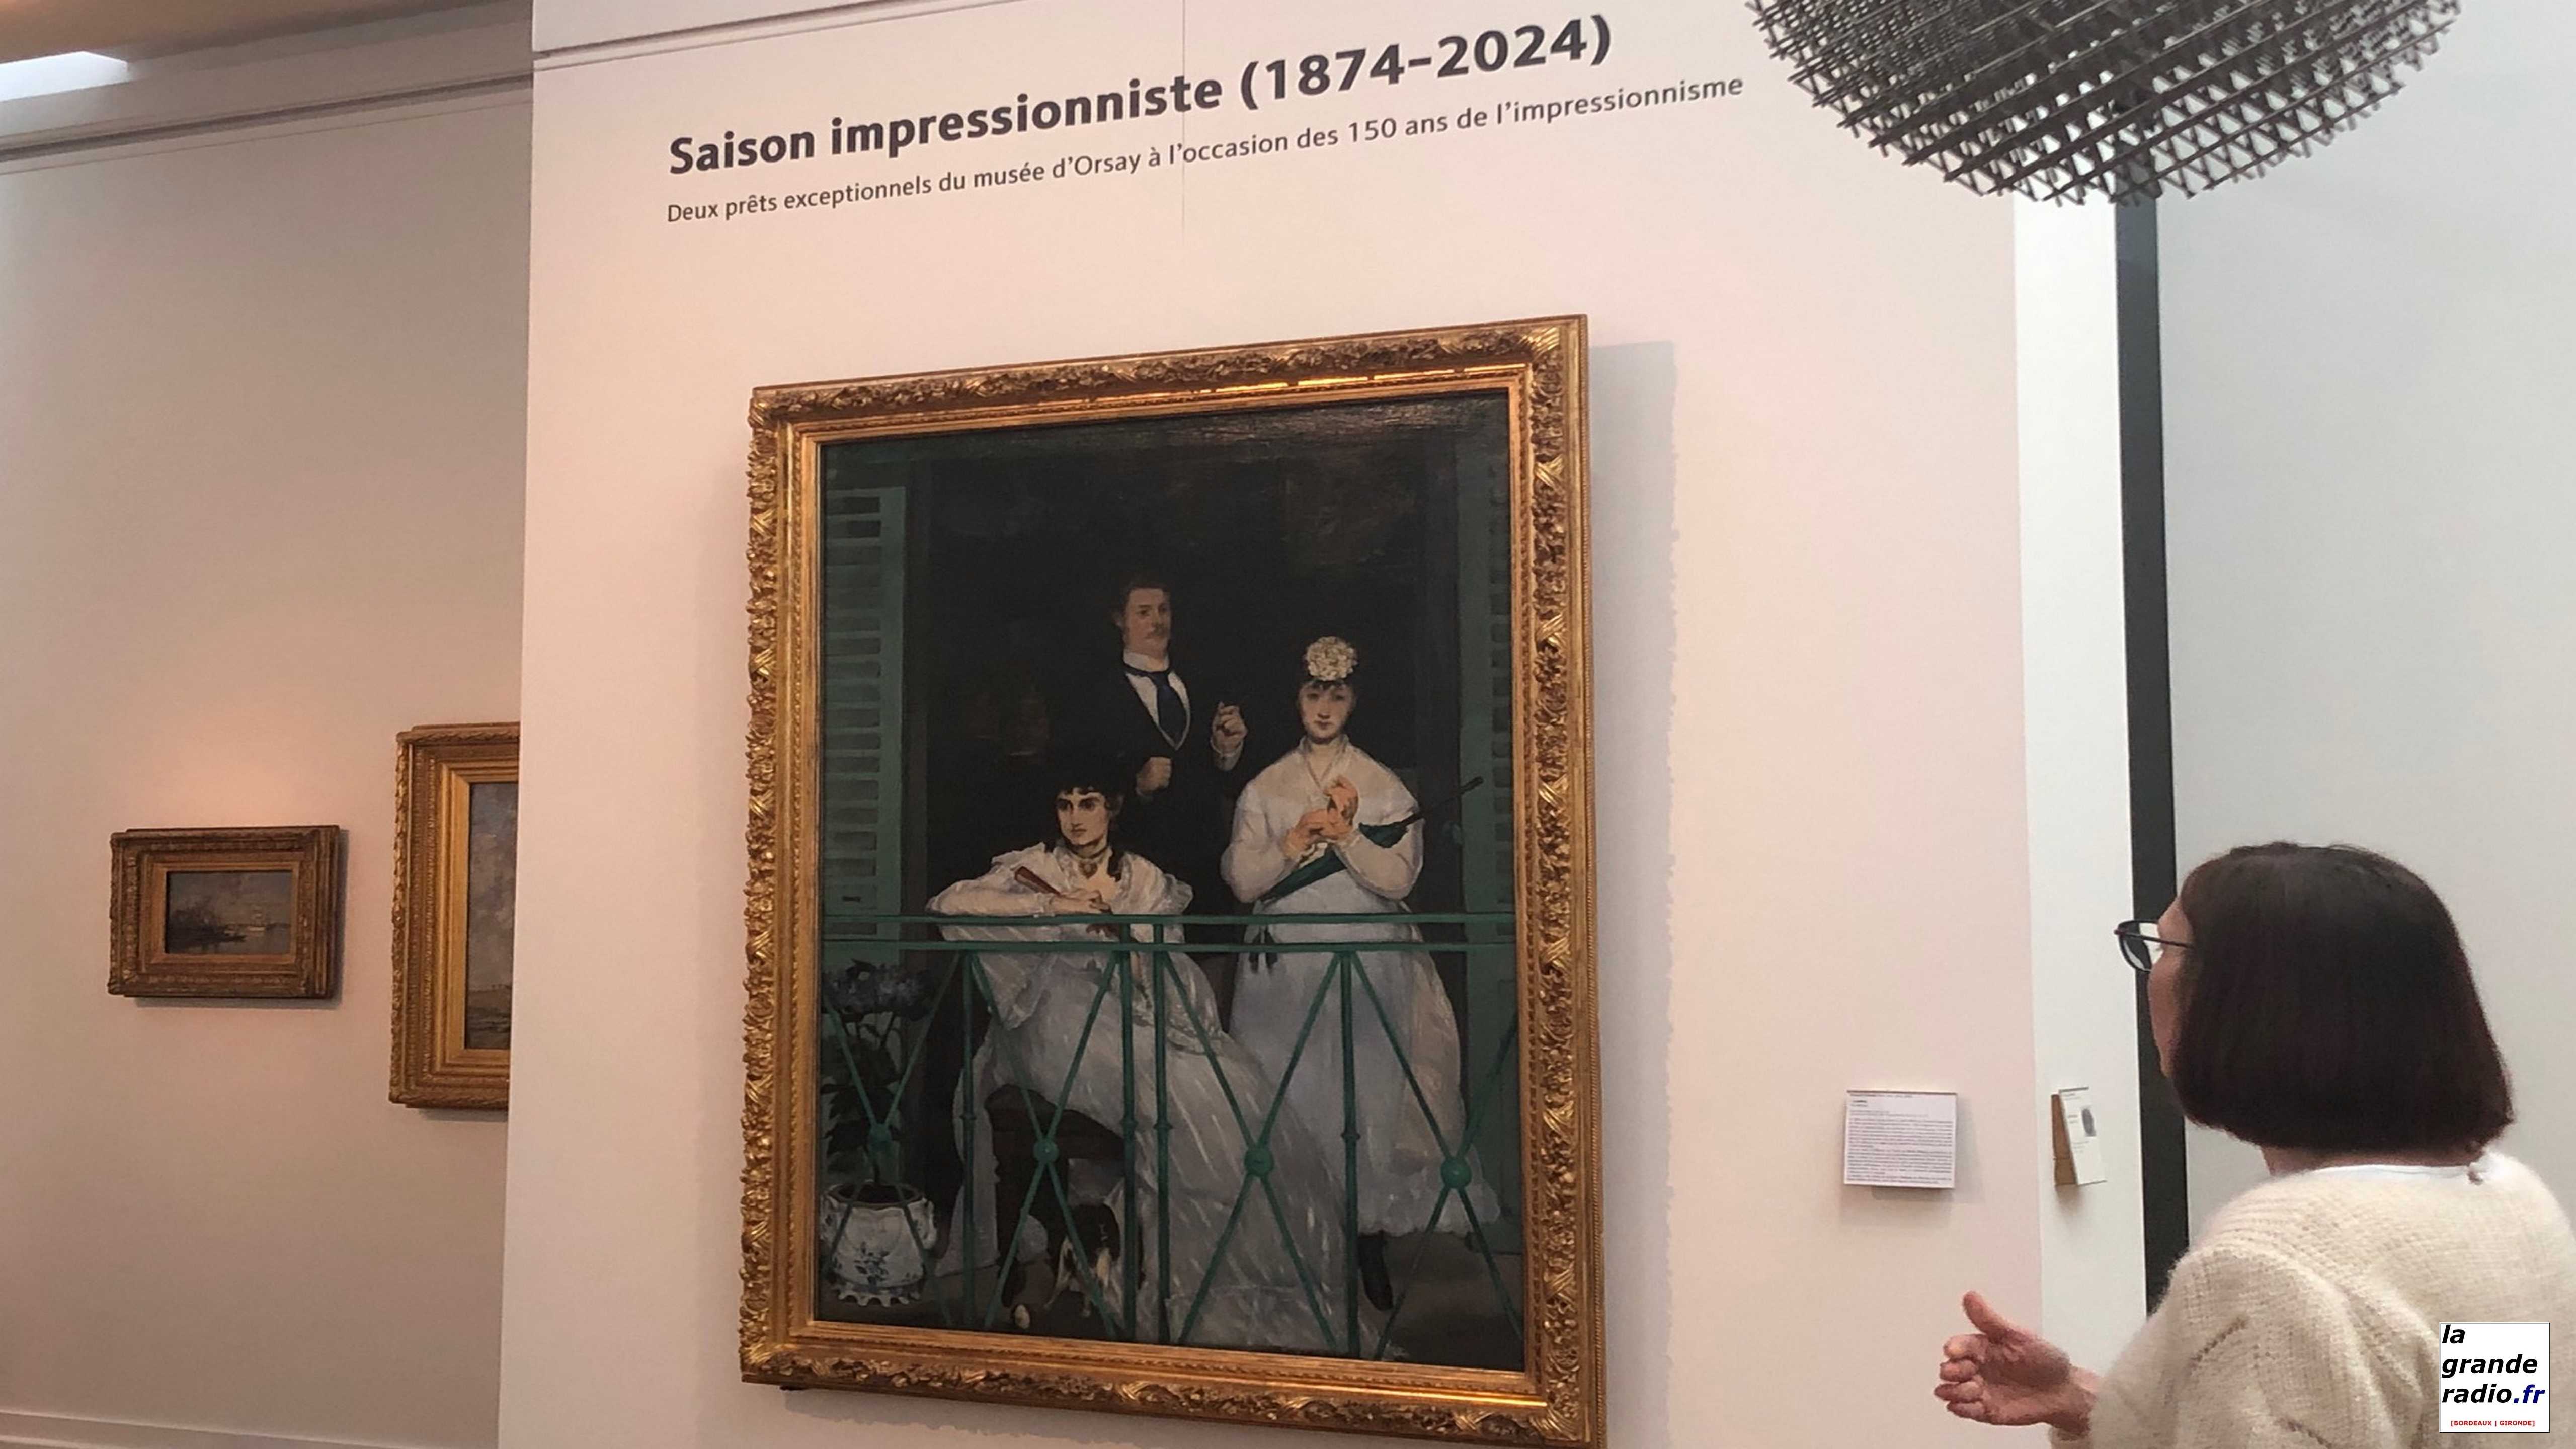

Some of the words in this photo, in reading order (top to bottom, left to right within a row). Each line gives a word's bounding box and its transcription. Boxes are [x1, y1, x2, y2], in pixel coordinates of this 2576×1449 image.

[668, 204, 718, 222] Deux
[726, 195, 777, 221] prêts
[784, 175, 932, 209] exceptionnels
[939, 172, 965, 191] du
[974, 162, 1045, 187] musée
[1148, 147, 1160, 167] à
[1297, 127, 1338, 148] des
[1349, 118, 1397, 142] 150
[1405, 116, 1448, 135] ans
[1457, 107, 1487, 129] de
[670, 131, 815, 174] Saison
[832, 75, 1222, 158] impressionniste
